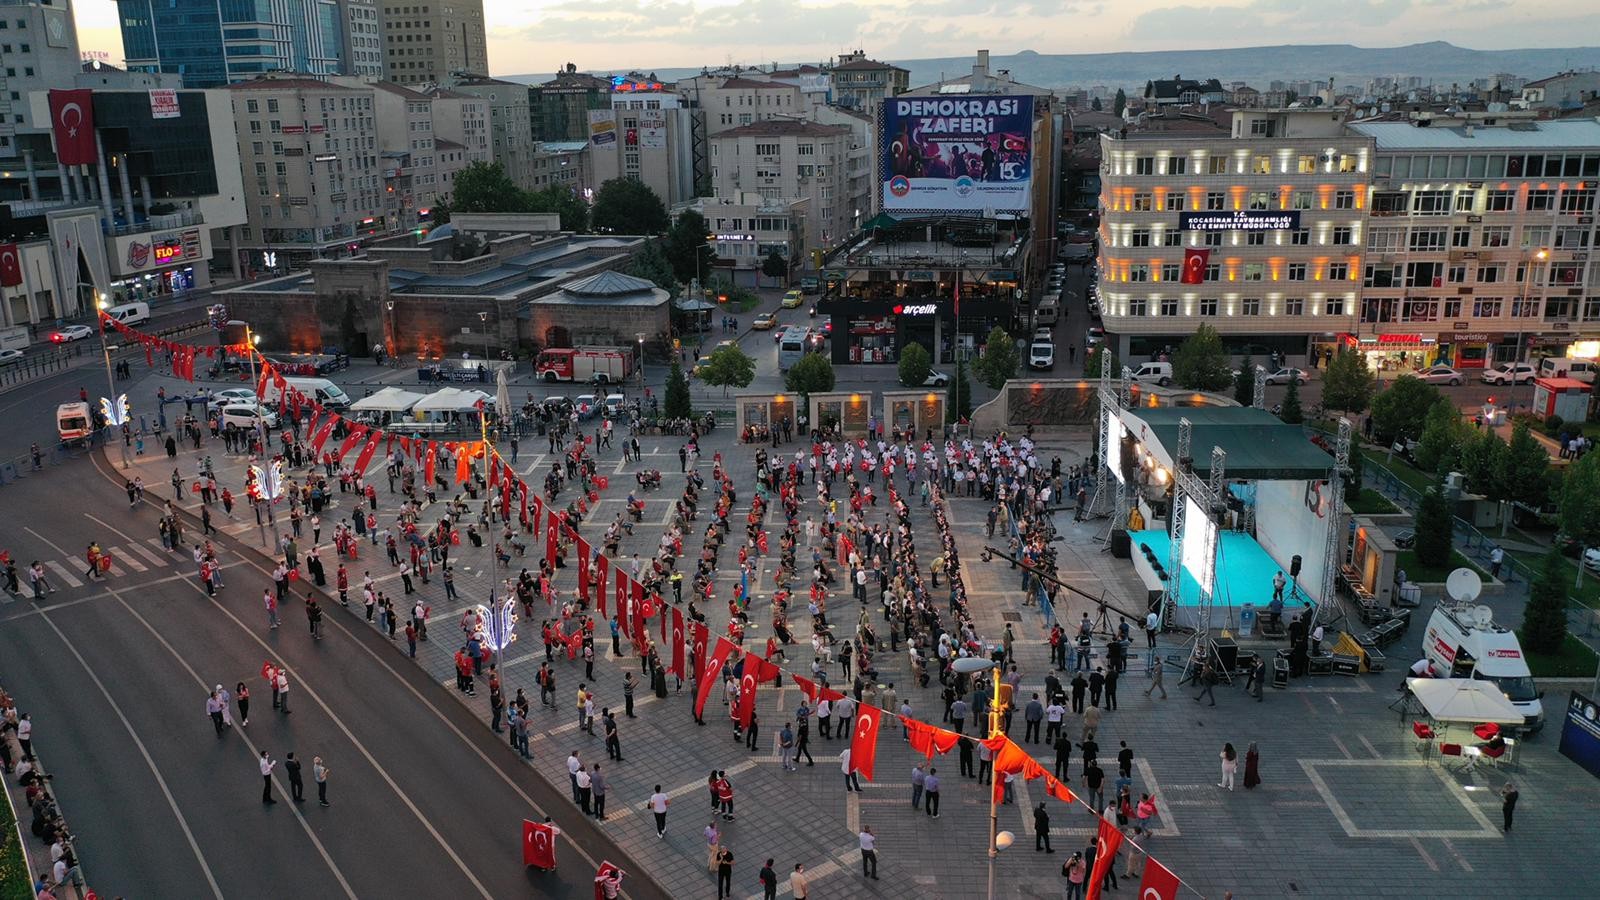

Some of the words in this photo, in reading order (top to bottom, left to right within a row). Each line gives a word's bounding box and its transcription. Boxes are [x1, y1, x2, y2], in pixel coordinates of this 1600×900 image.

[897, 100, 1018, 117] DEMOKRASİ
[920, 118, 994, 134] ZAFERİ
[156, 247, 173, 258] FLO
[903, 304, 937, 316] arçelik
